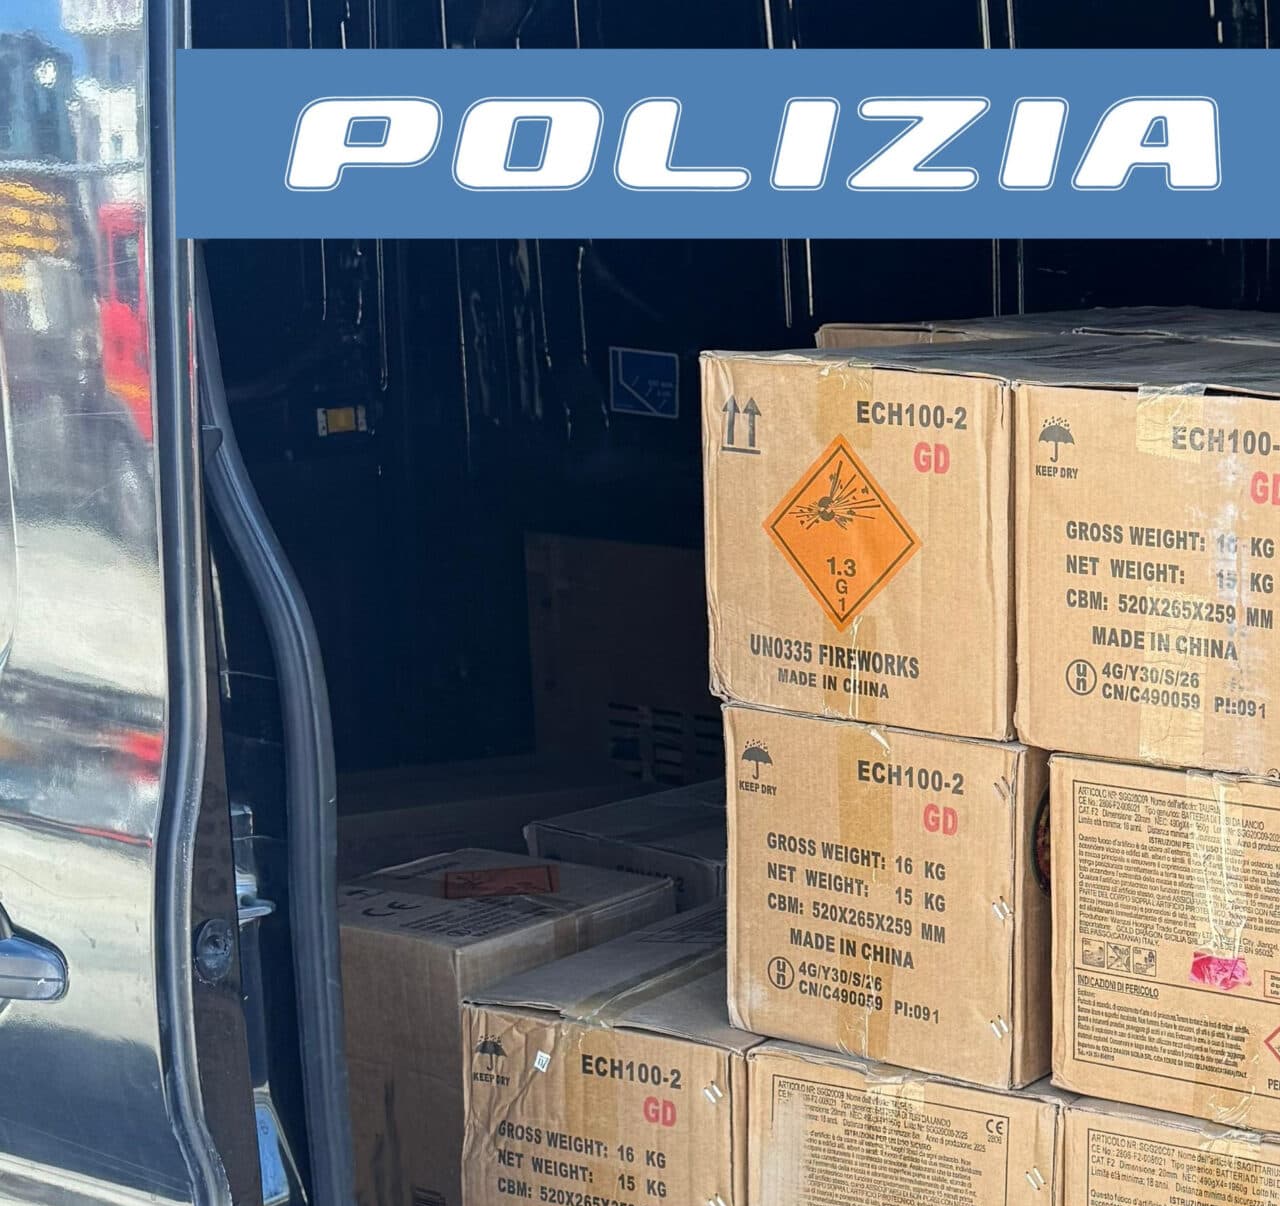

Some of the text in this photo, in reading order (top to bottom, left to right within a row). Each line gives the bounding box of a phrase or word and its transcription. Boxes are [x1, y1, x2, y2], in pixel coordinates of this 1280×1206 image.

[857, 401, 967, 430] ECH100-2
[914, 442, 950, 474] GD
[1036, 465, 1078, 479] KEEP DRY
[1067, 521, 1274, 558] GROSS WEIGHT: KG
[827, 558, 856, 577] 1.3
[837, 579, 847, 593] G
[839, 598, 844, 611] 1
[750, 634, 919, 679] UN0335 FIREWORKS
[1092, 627, 1238, 660] MADE IN CHINA
[778, 668, 888, 698] MADE IN CHINA
[739, 780, 777, 796] KEEP DRY
[858, 760, 964, 795] ECH100-2
[924, 804, 958, 836] GD
[799, 962, 882, 991] 4G/Y30/S/26
[799, 980, 939, 1023] CN/C490059 PI:091
[582, 1054, 682, 1089] ECH100-2
[644, 1096, 676, 1127] GD
[498, 1120, 666, 1168] GROSS WEIGHT: 16 KG
